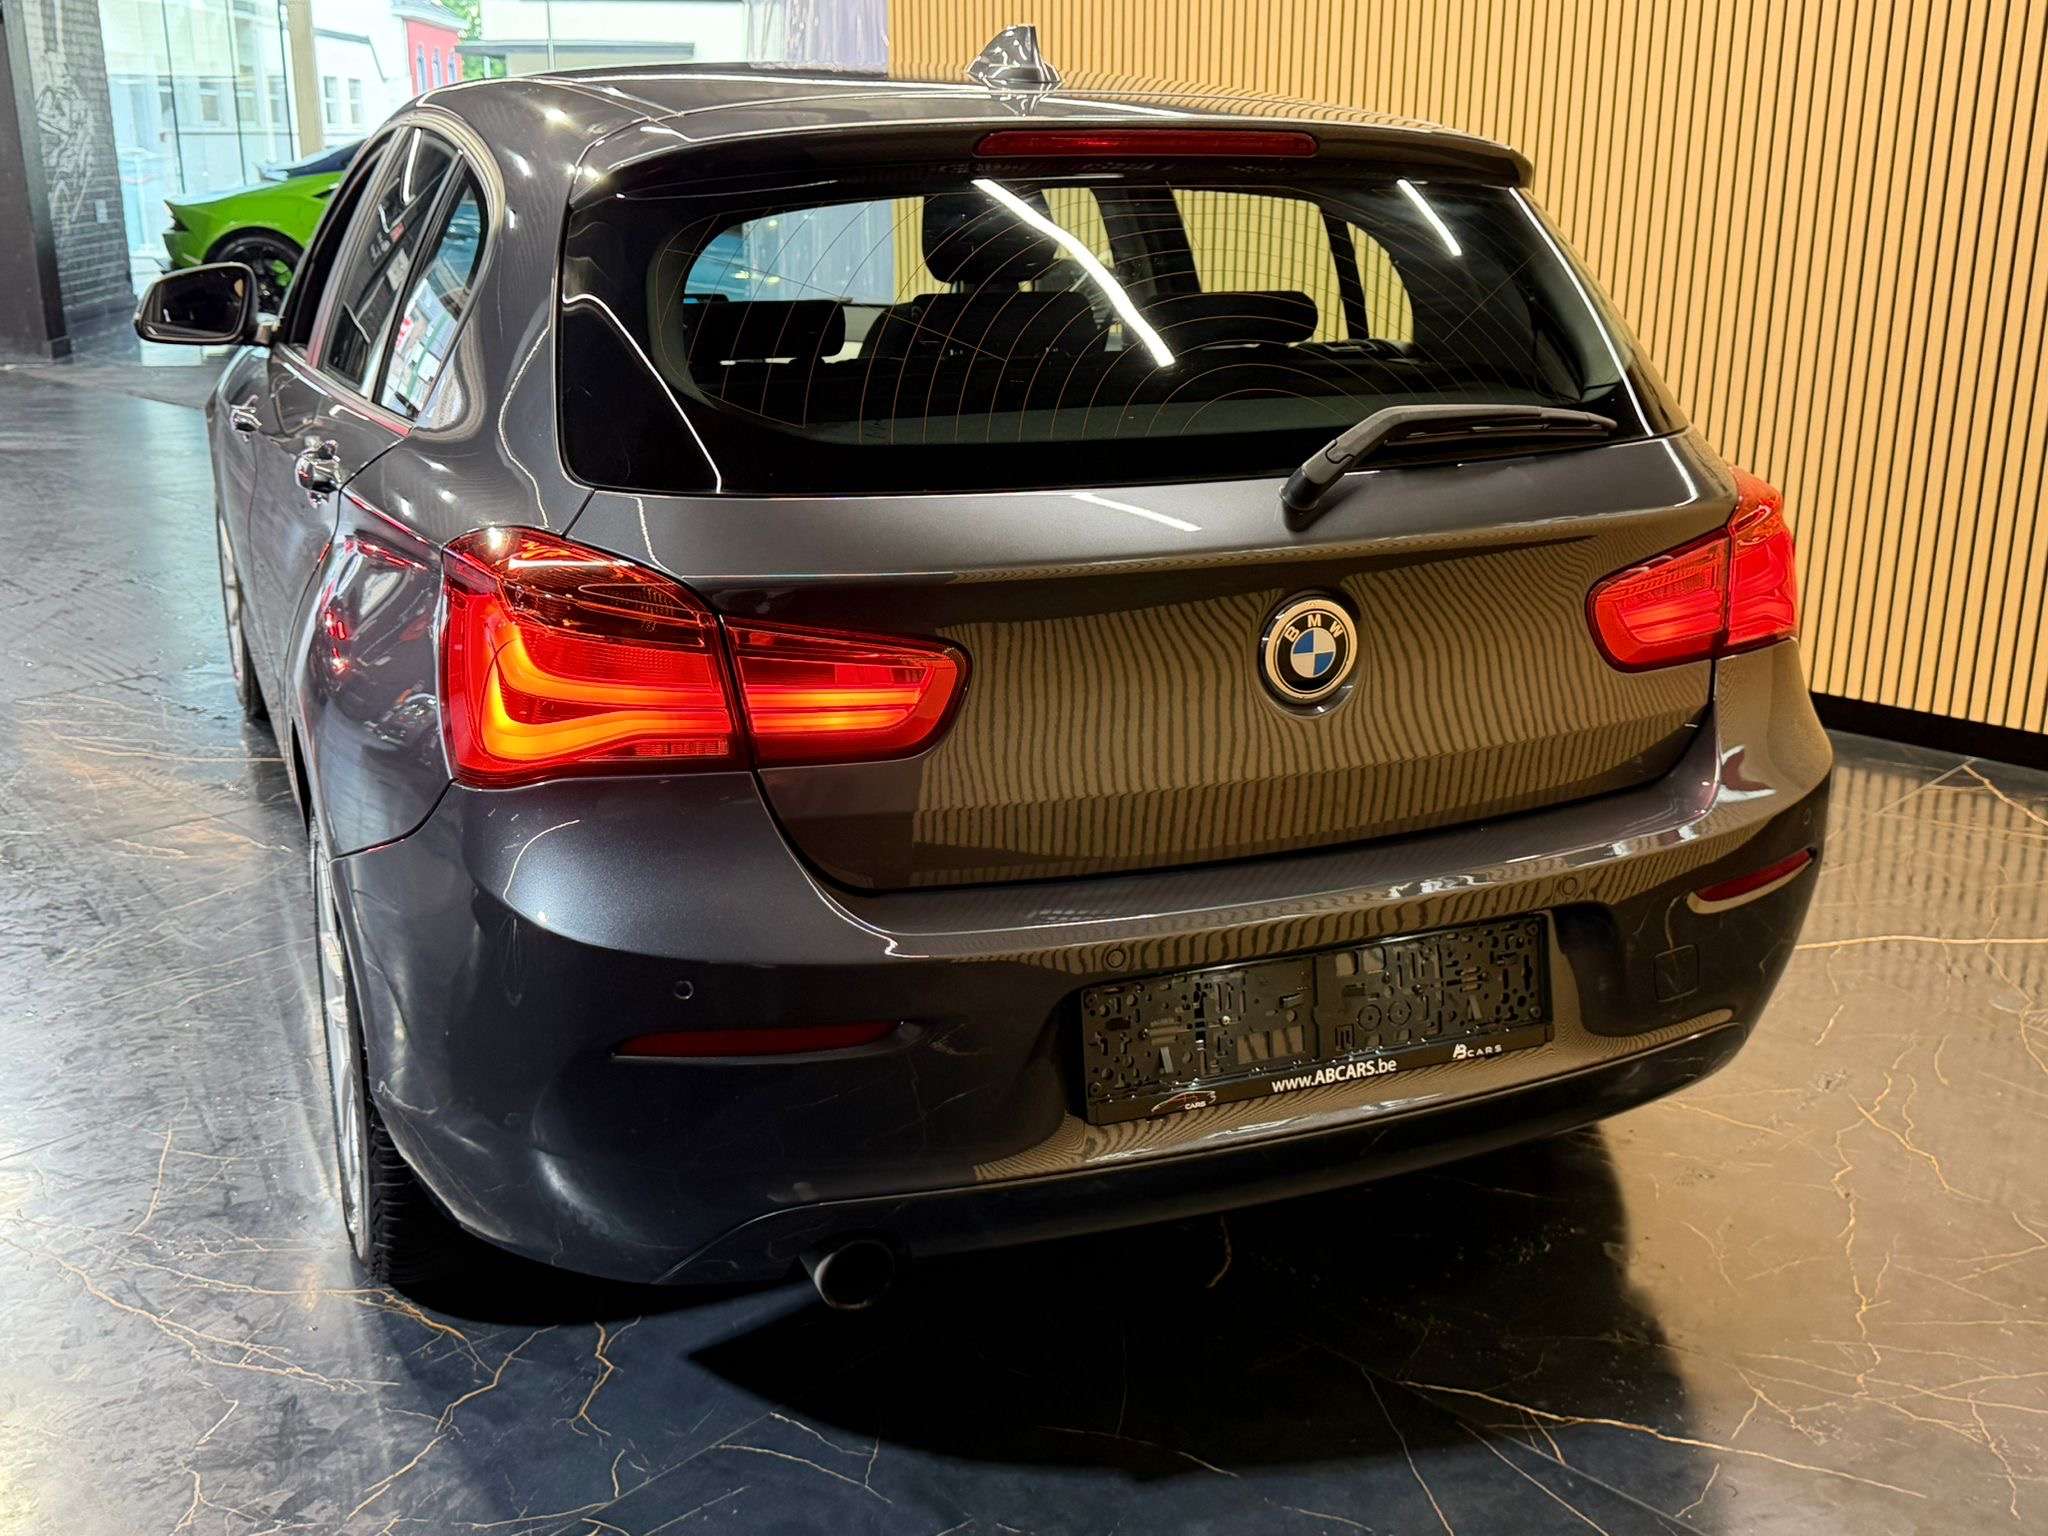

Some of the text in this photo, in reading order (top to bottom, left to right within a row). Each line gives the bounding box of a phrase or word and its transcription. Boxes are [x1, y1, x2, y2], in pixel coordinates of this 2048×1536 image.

[1284, 613, 1343, 642] BMW
[1272, 1058, 1397, 1093] www.ABCARS.be
[1184, 1100, 1206, 1110] CARS
